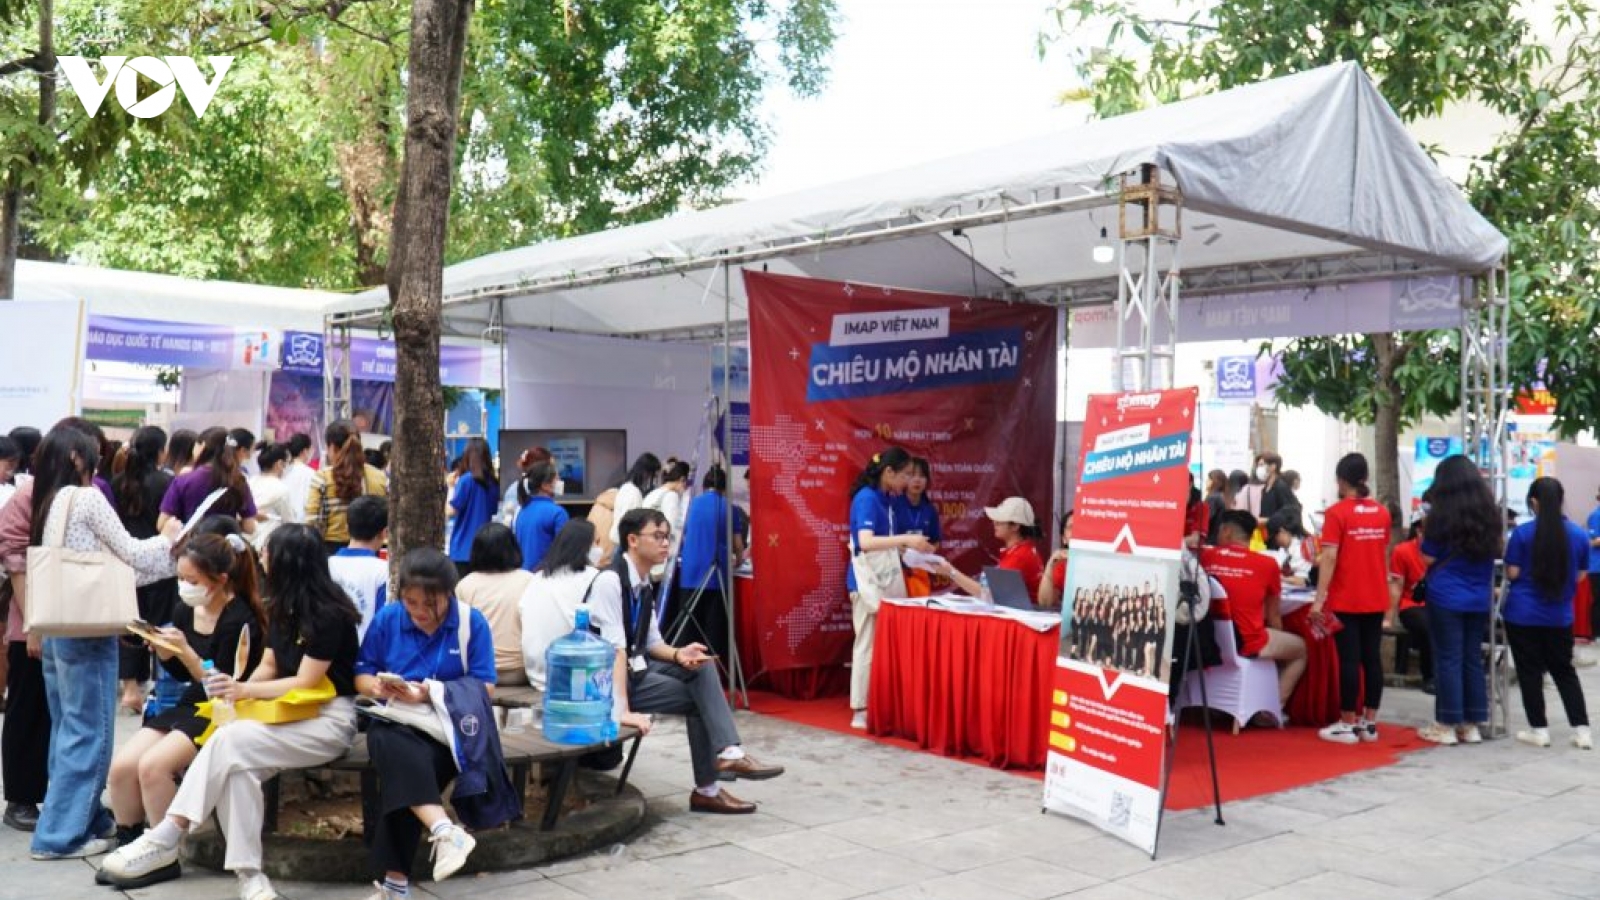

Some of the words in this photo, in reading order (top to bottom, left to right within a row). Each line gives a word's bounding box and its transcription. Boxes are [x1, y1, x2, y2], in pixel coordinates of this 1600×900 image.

[844, 322, 878, 335] IMAP
[882, 318, 908, 335] VIỆT
[911, 317, 939, 330] NAM
[812, 354, 880, 386] CHIÊU
[885, 350, 920, 383] MỘ
[925, 346, 982, 376] NHÂN
[988, 341, 1018, 368] TÀI
[1085, 455, 1115, 475] CHIÊU
[1115, 450, 1134, 471] MỘ
[1134, 445, 1168, 466] NHÂN
[1169, 440, 1187, 459] TÀI
